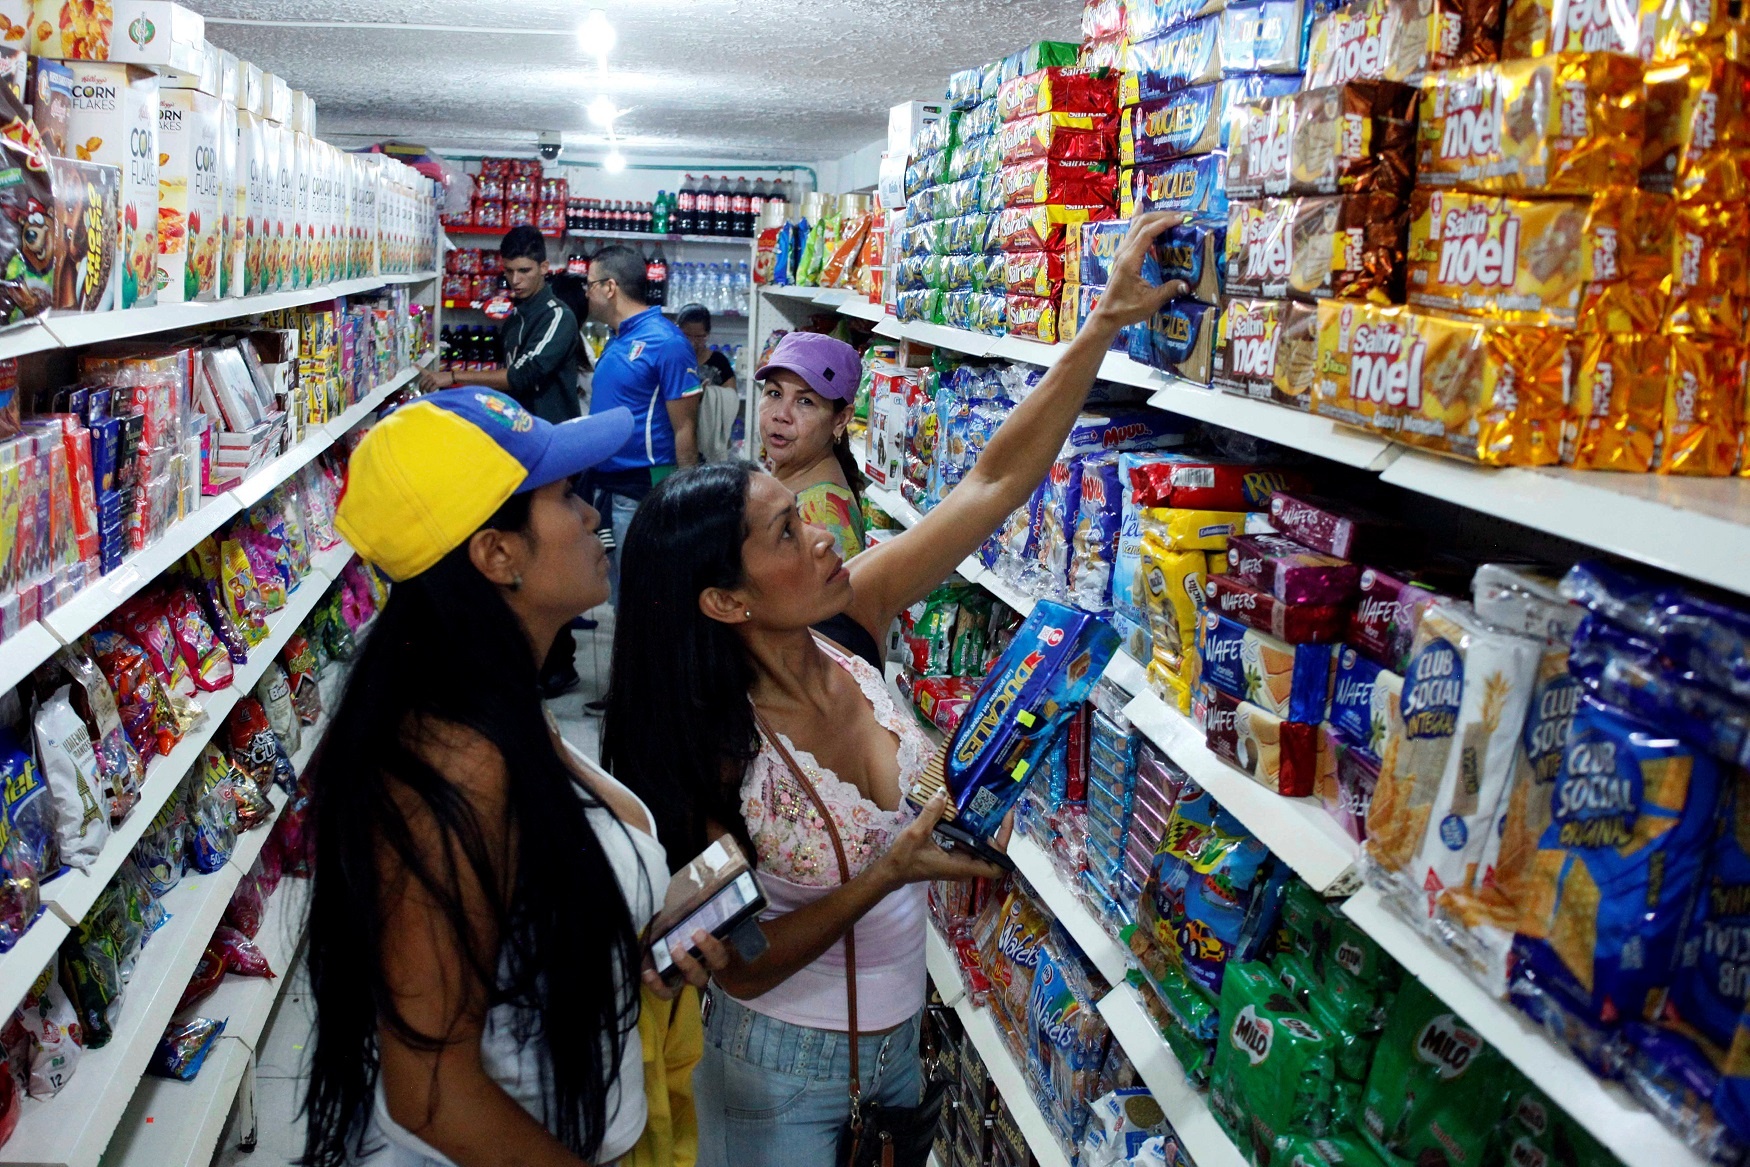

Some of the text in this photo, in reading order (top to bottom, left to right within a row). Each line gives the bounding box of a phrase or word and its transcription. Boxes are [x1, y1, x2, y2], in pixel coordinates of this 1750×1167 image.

[1333, 17, 1391, 83] noel
[72, 85, 115, 99] CORN
[72, 99, 115, 111] FLAKES
[1149, 103, 1198, 137] DUCALES
[1441, 73, 1500, 159] noel
[131, 127, 153, 159] COR
[1248, 99, 1296, 179] noel
[195, 145, 217, 172] COR
[1246, 223, 1293, 279] noel
[1347, 228, 1363, 271] noel
[1438, 217, 1519, 287] noel
[1233, 323, 1281, 377] noel
[1350, 342, 1426, 408] noel
[1281, 505, 1320, 525] WAFERS
[1220, 591, 1258, 610] WAFERS
[1357, 595, 1414, 624] WAFERS
[1205, 634, 1258, 663] WAFERS
[1416, 648, 1453, 680] CLUB
[1337, 676, 1389, 711] WAFERS
[1404, 680, 1461, 716] SOCIAL
[958, 662, 1039, 768] DUCALES
[1207, 706, 1250, 736] WAFERS
[1557, 776, 1636, 817] SOCIAL
[1235, 1014, 1268, 1056] MILO
[1420, 1024, 1471, 1070] MILO
[50, 1073, 63, 1090] 12
